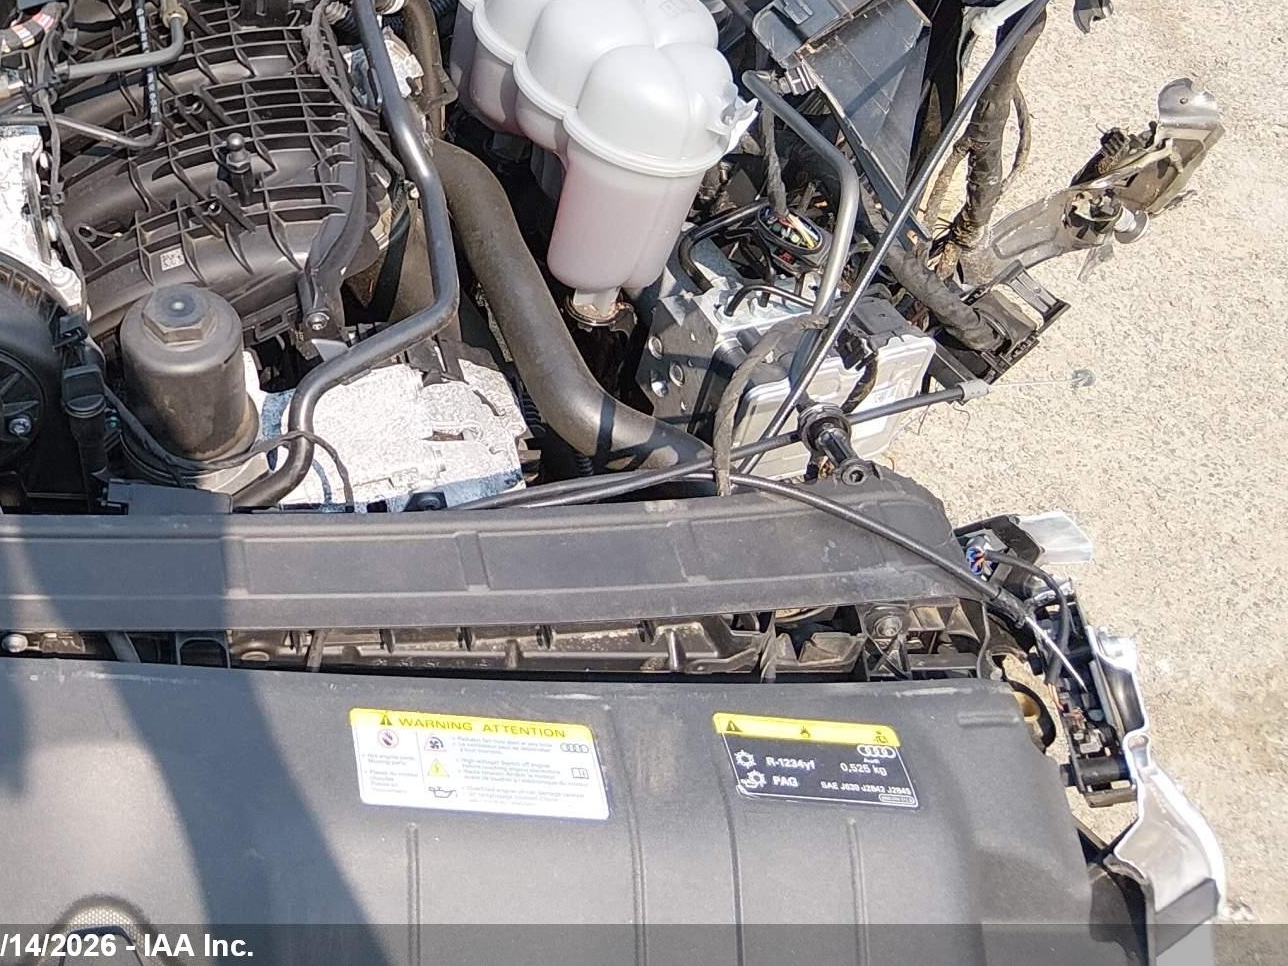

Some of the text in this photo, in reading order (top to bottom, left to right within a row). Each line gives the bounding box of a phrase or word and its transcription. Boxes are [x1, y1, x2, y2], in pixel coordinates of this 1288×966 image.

[398, 718, 567, 738] WARNING ATTENTION
[765, 756, 816, 771] R-1234yf
[873, 764, 889, 777] kg
[772, 775, 799, 787] PAG
